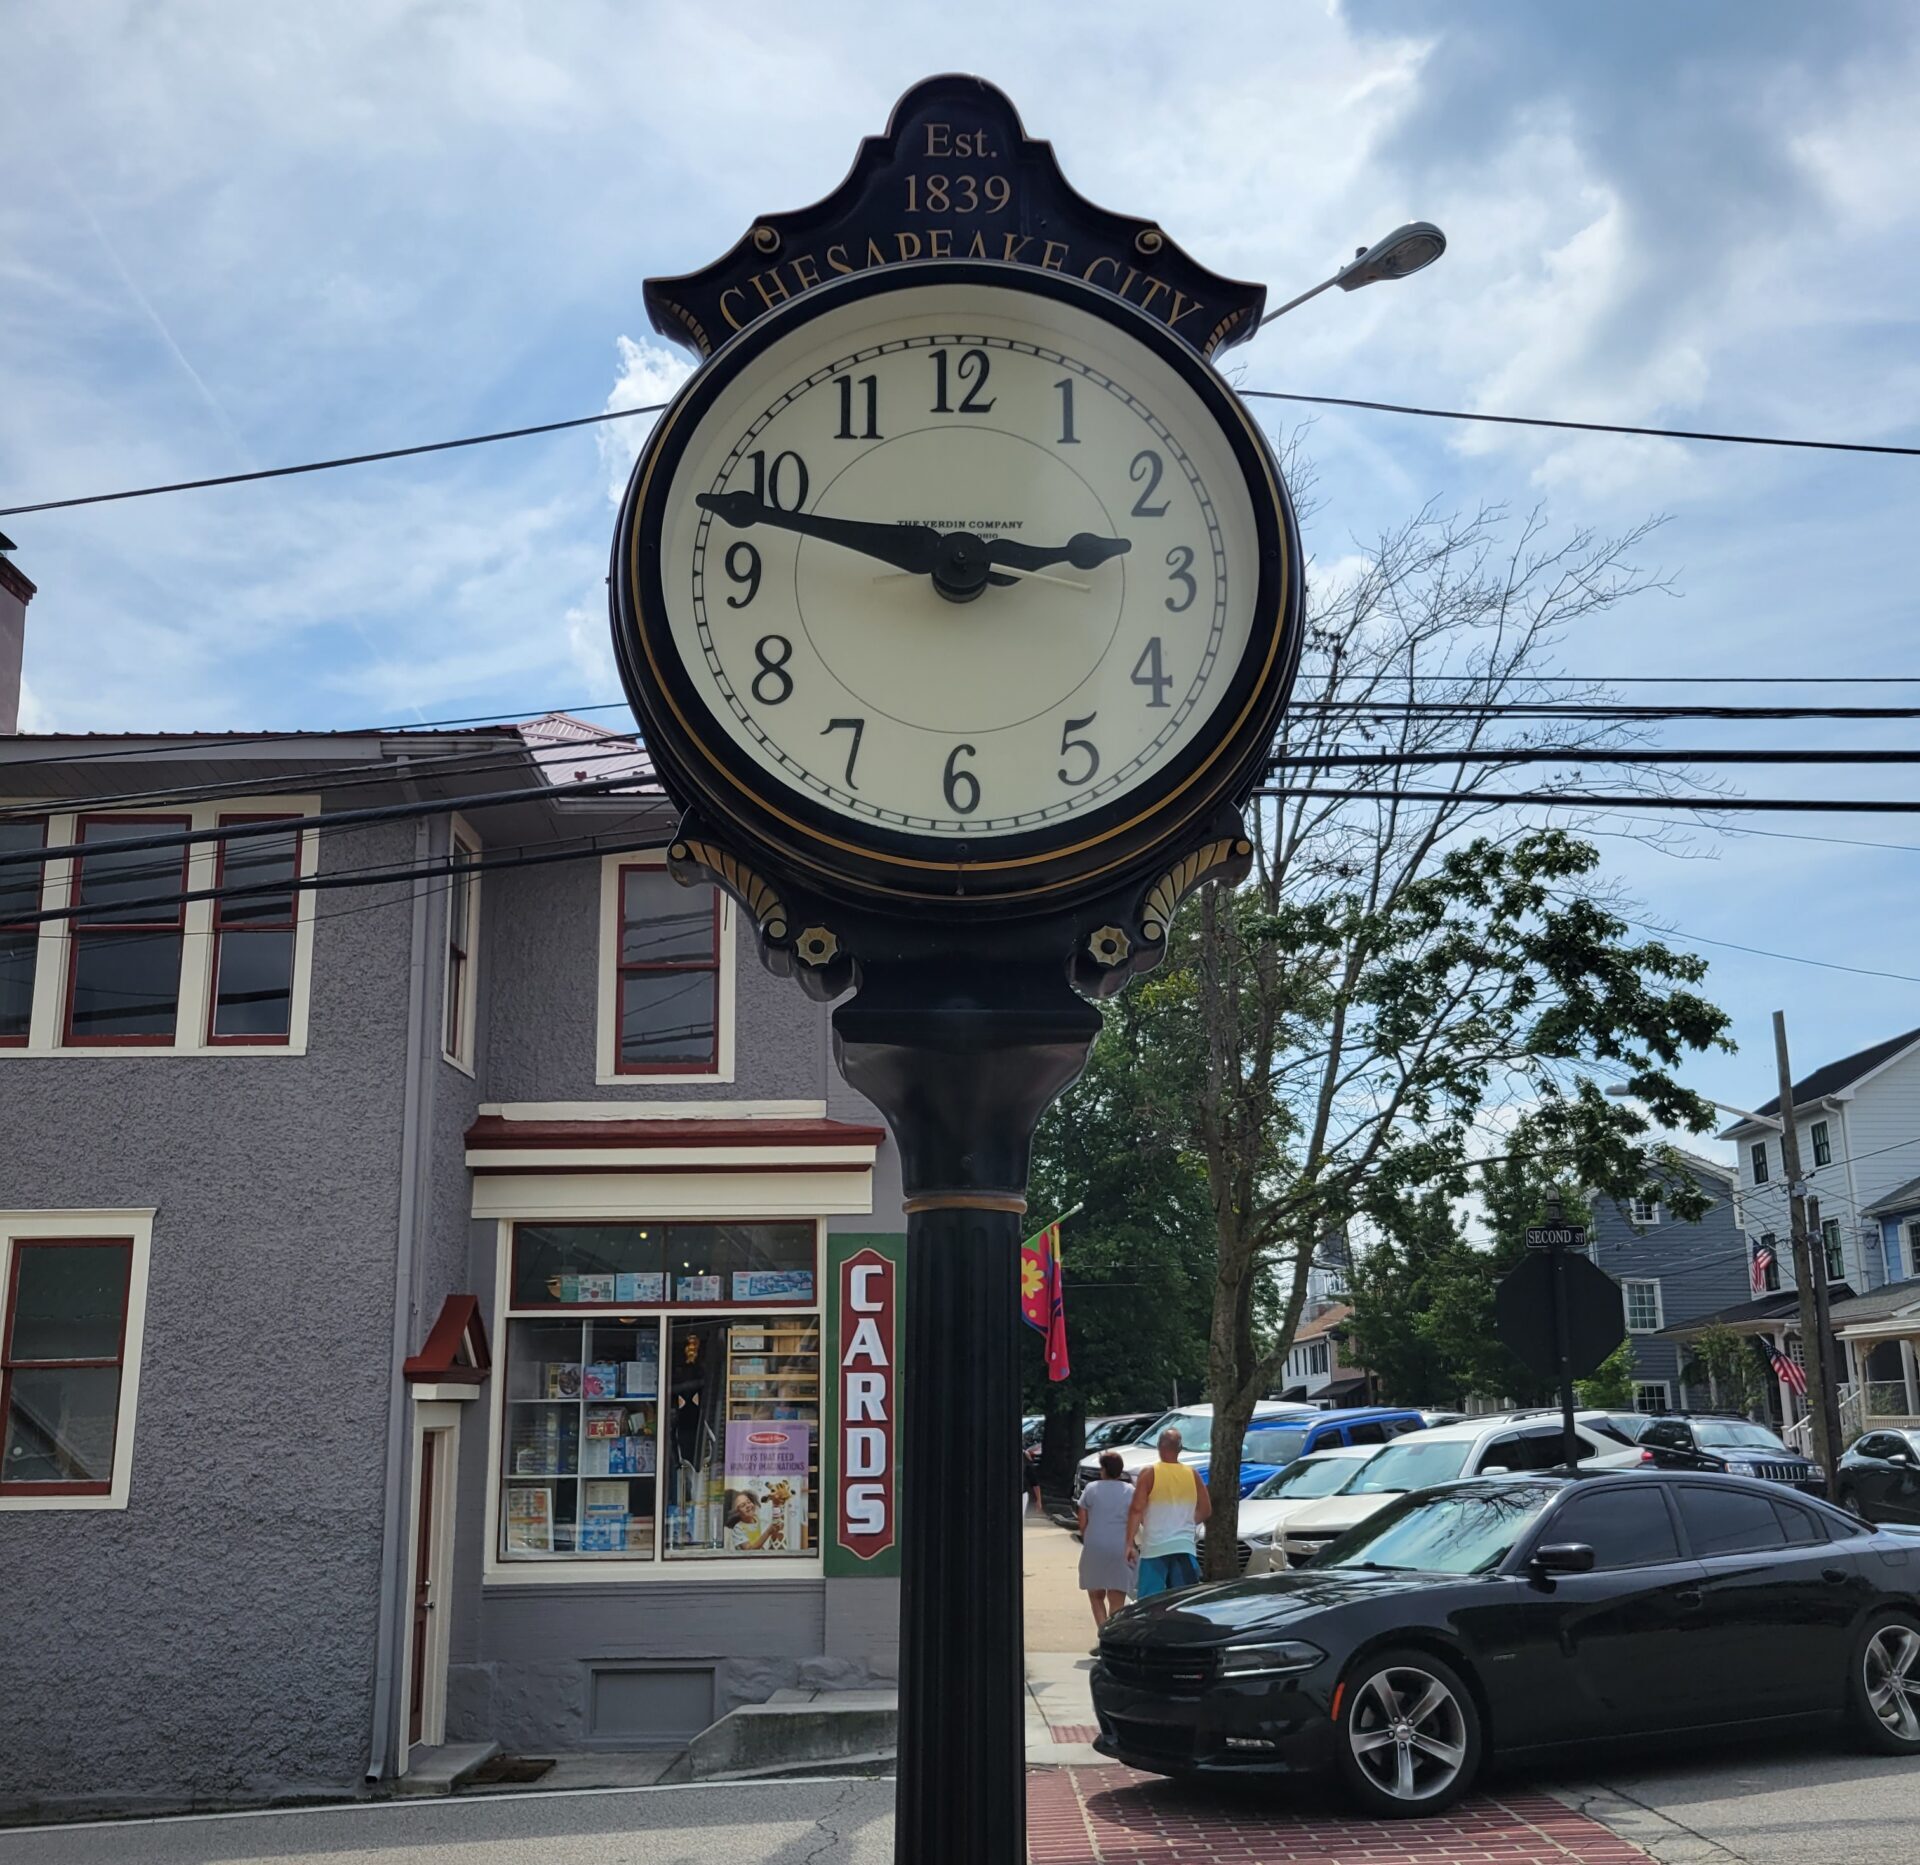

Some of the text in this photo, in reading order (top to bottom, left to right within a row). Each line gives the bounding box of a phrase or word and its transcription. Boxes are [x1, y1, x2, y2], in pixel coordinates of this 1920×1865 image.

[922, 123, 998, 159] Est.
[903, 175, 1011, 214] 1839
[719, 229, 1204, 331] CHESAPEAKE CITY
[832, 374, 885, 440] 11
[928, 349, 997, 414] 12
[1053, 378, 1082, 444] 1
[746, 450, 809, 514] 10
[1128, 450, 1171, 518] 2
[922, 520, 966, 529] VERDIN
[968, 520, 1024, 529] COMPANY
[724, 541, 762, 609] 9
[1164, 546, 1198, 613] 3
[751, 635, 794, 705] 8
[1129, 637, 1174, 708] 4
[820, 718, 865, 790] 7
[942, 744, 981, 815] 6
[1057, 711, 1100, 786] 5
[1528, 1230, 1584, 1244] SECOND ST
[842, 1264, 890, 1535] CARDS
[777, 1452, 794, 1461] FEED
